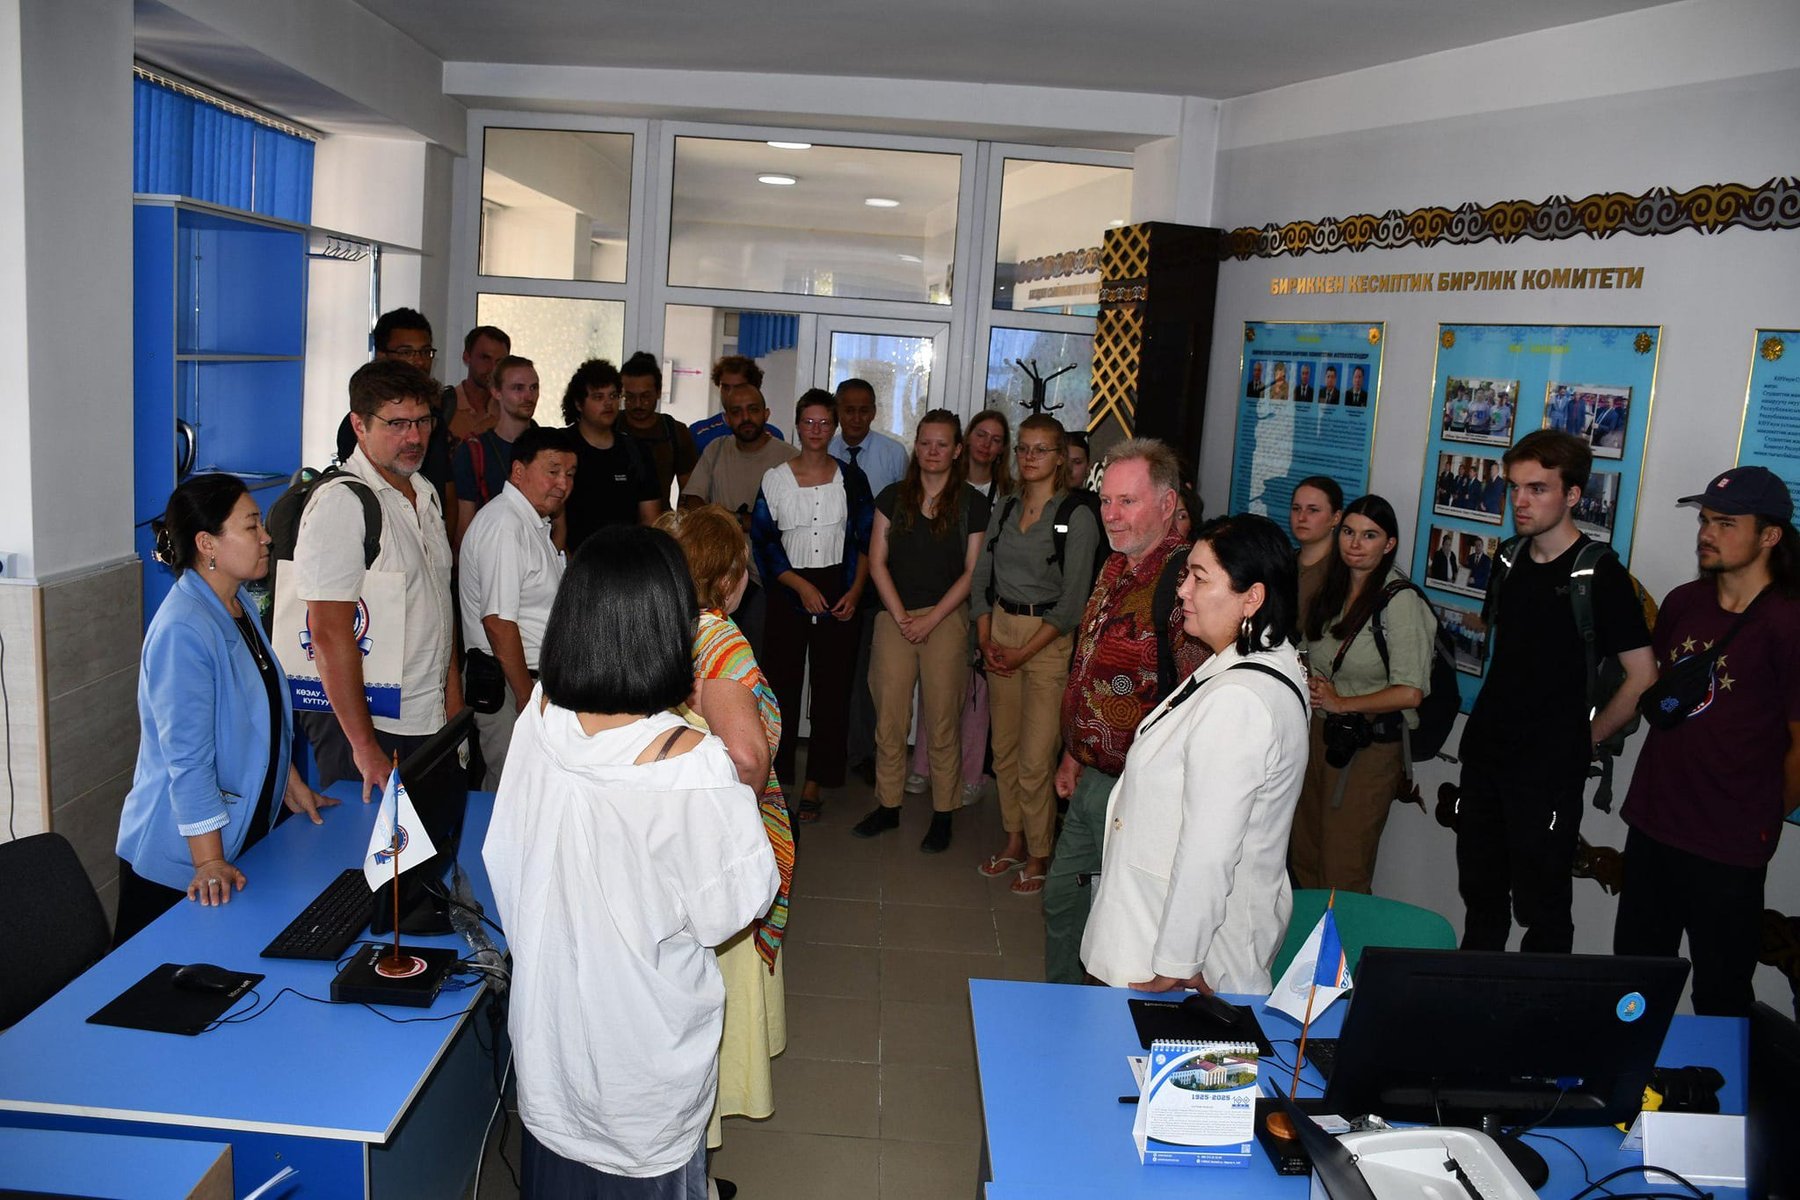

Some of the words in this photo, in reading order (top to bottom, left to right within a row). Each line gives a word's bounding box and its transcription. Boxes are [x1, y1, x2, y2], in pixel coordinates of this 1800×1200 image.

[1270, 275, 1345, 296] БИРИККЕН
[1348, 272, 1434, 293] КЕСИПТИК
[1437, 269, 1517, 292] БИРЛИК
[1520, 266, 1645, 290] КОМИТЕТИ
[1191, 1093, 1231, 1101] 1925-2025
